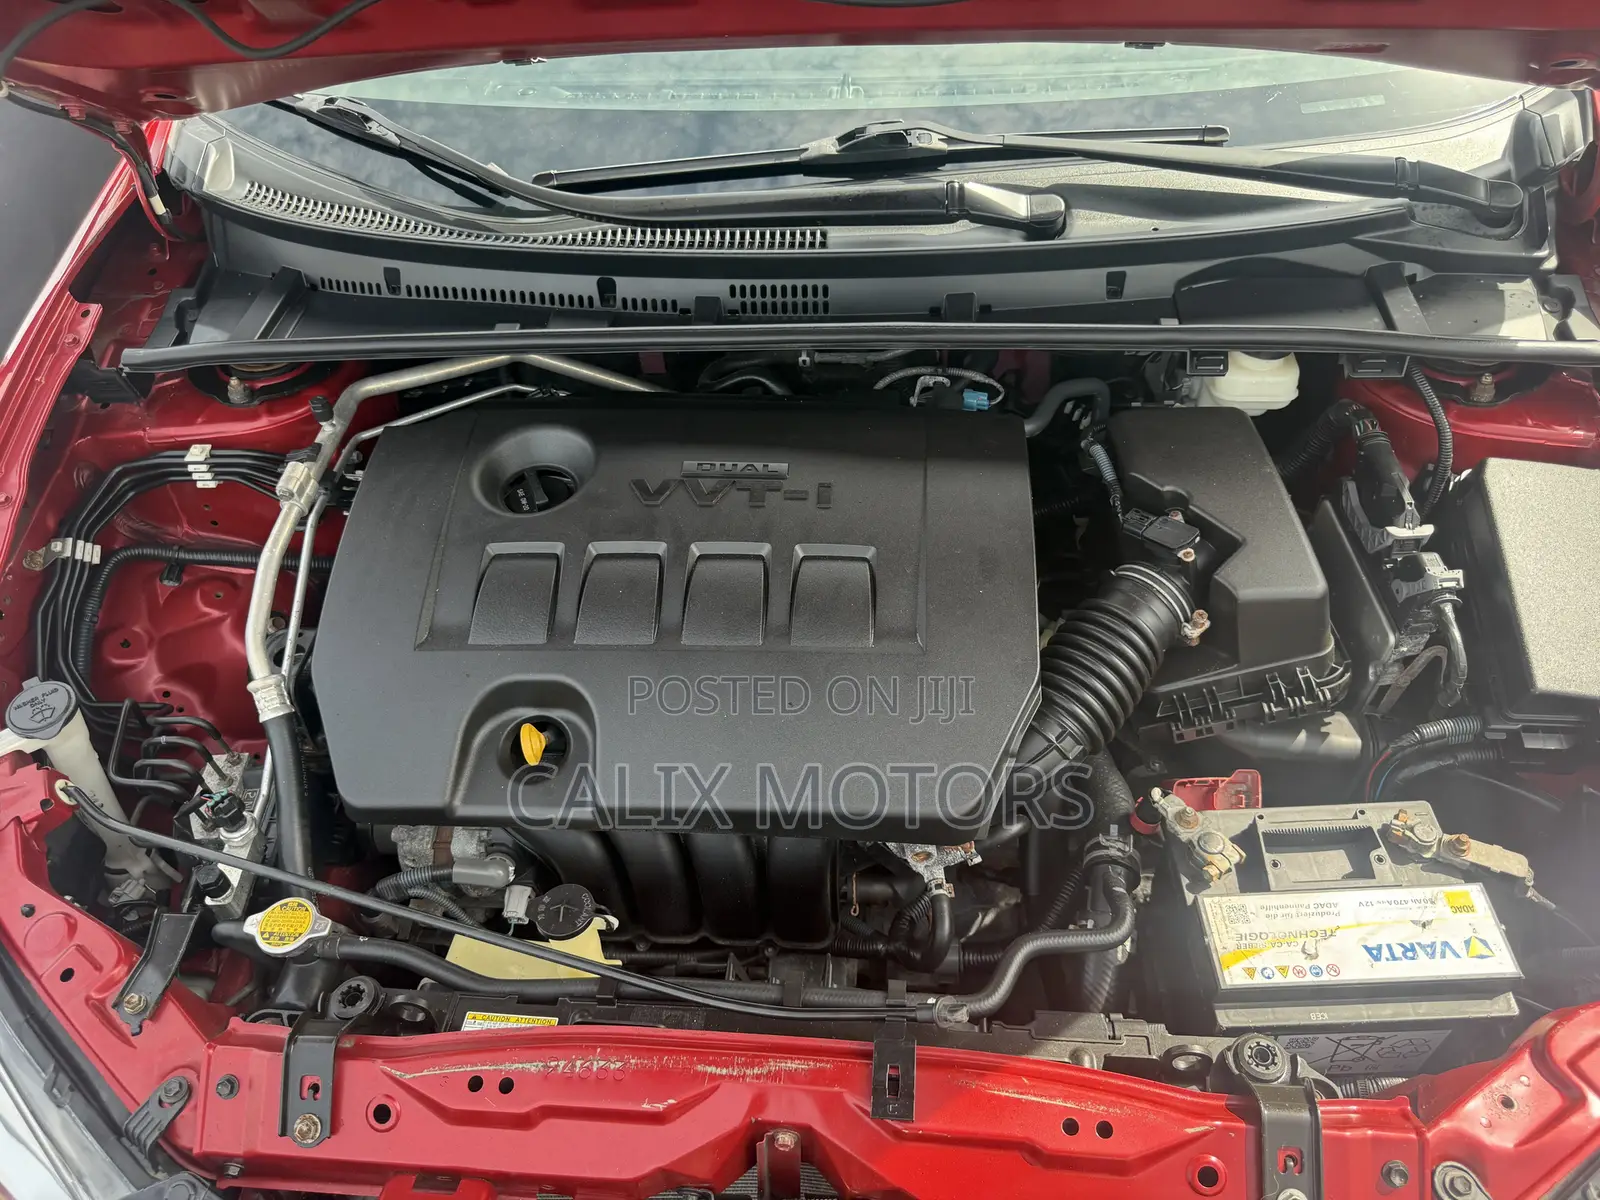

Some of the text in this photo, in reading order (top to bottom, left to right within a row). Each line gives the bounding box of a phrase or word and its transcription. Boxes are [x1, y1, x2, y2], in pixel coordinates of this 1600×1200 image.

[696, 462, 779, 473] DUAL
[1260, 903, 1311, 911] Pannenhilfe
[1358, 900, 1374, 908] 12V
[1450, 903, 1475, 914] ADAC
[1295, 910, 1341, 919] Produziert
[1235, 929, 1337, 941] TECHNOLOGIE
[1361, 942, 1462, 963] VARTA
[482, 1014, 511, 1022] CAUTION
[516, 1016, 552, 1025] ATTENTION
